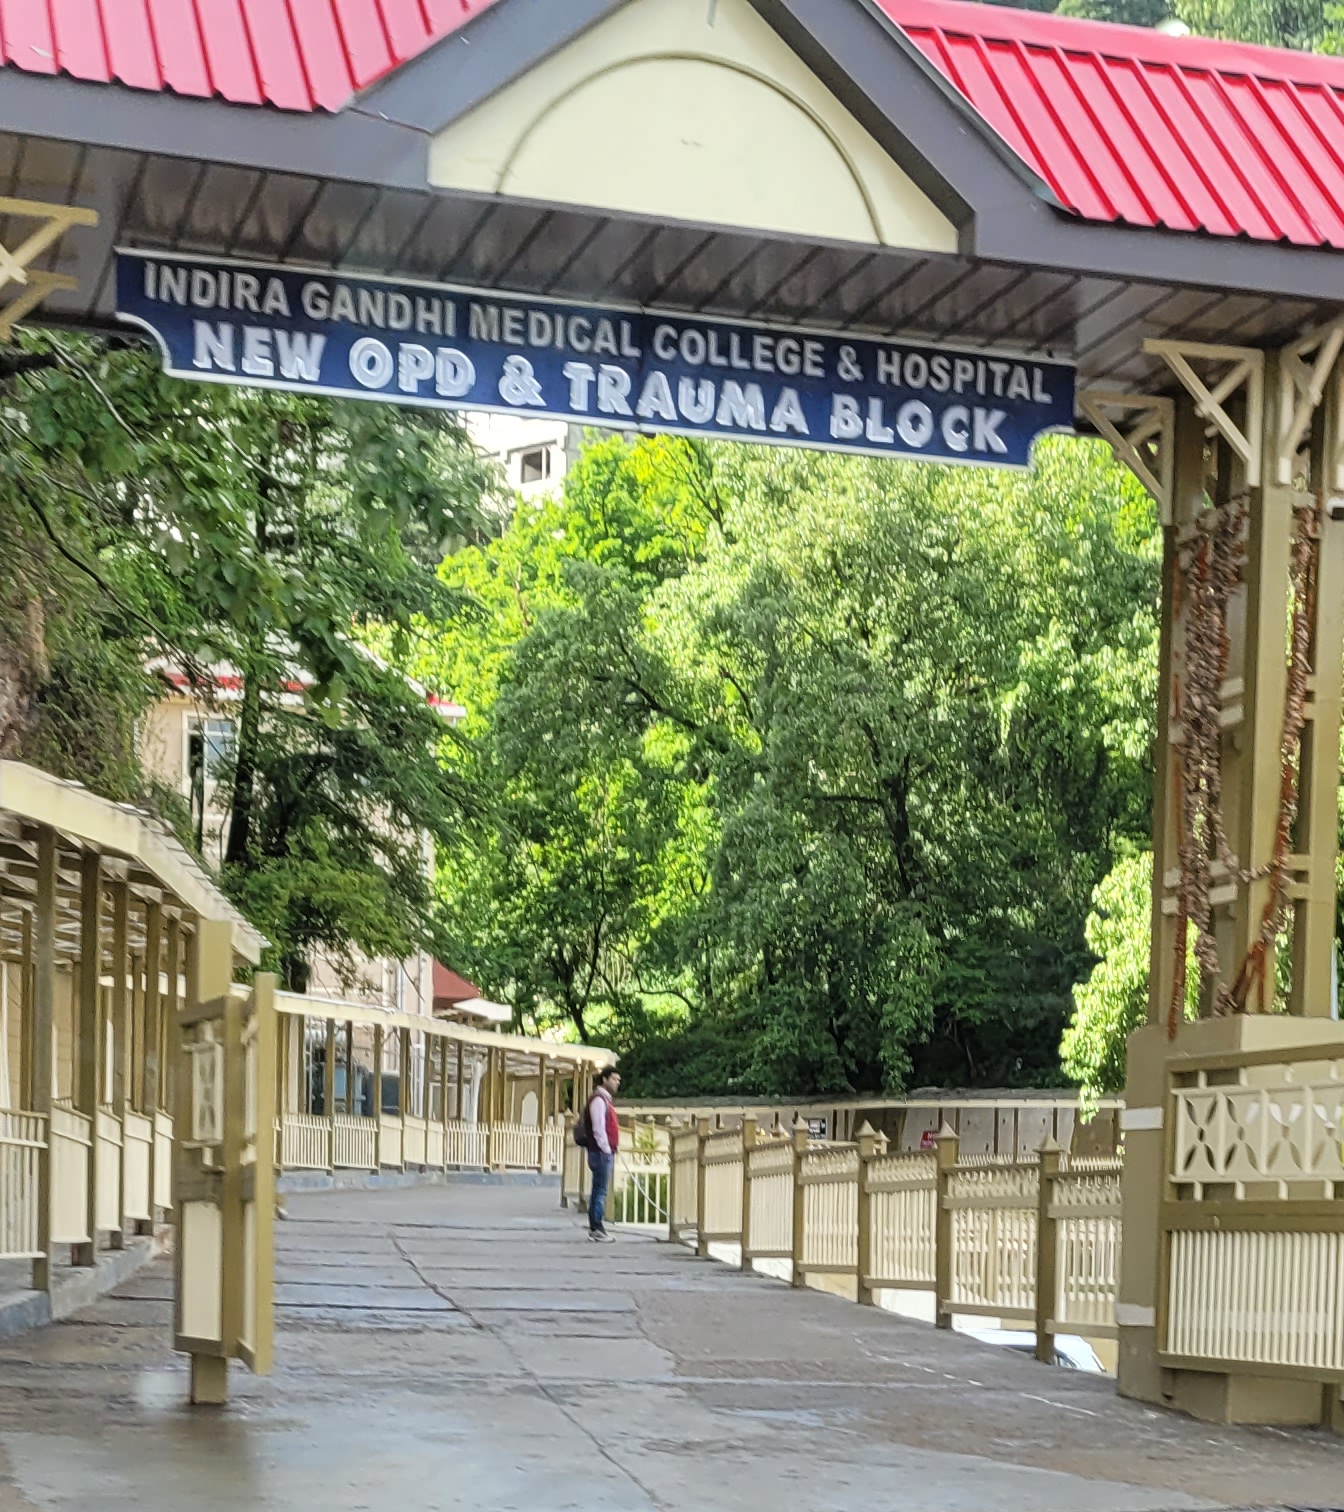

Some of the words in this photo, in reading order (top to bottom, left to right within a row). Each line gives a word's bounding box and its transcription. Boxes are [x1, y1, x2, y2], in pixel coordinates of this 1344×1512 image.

[143, 260, 291, 318] INDIRA
[301, 280, 455, 337] GANDHI
[469, 301, 642, 357] MEDICAL
[654, 323, 825, 378] COLLEGE
[837, 345, 863, 382] &
[877, 349, 1053, 404] HOSPITAL
[192, 319, 327, 382] NEW
[348, 337, 476, 398] OPD
[498, 354, 547, 407] &
[562, 361, 810, 435] TRAUMA
[829, 391, 1009, 454] BLOCK
